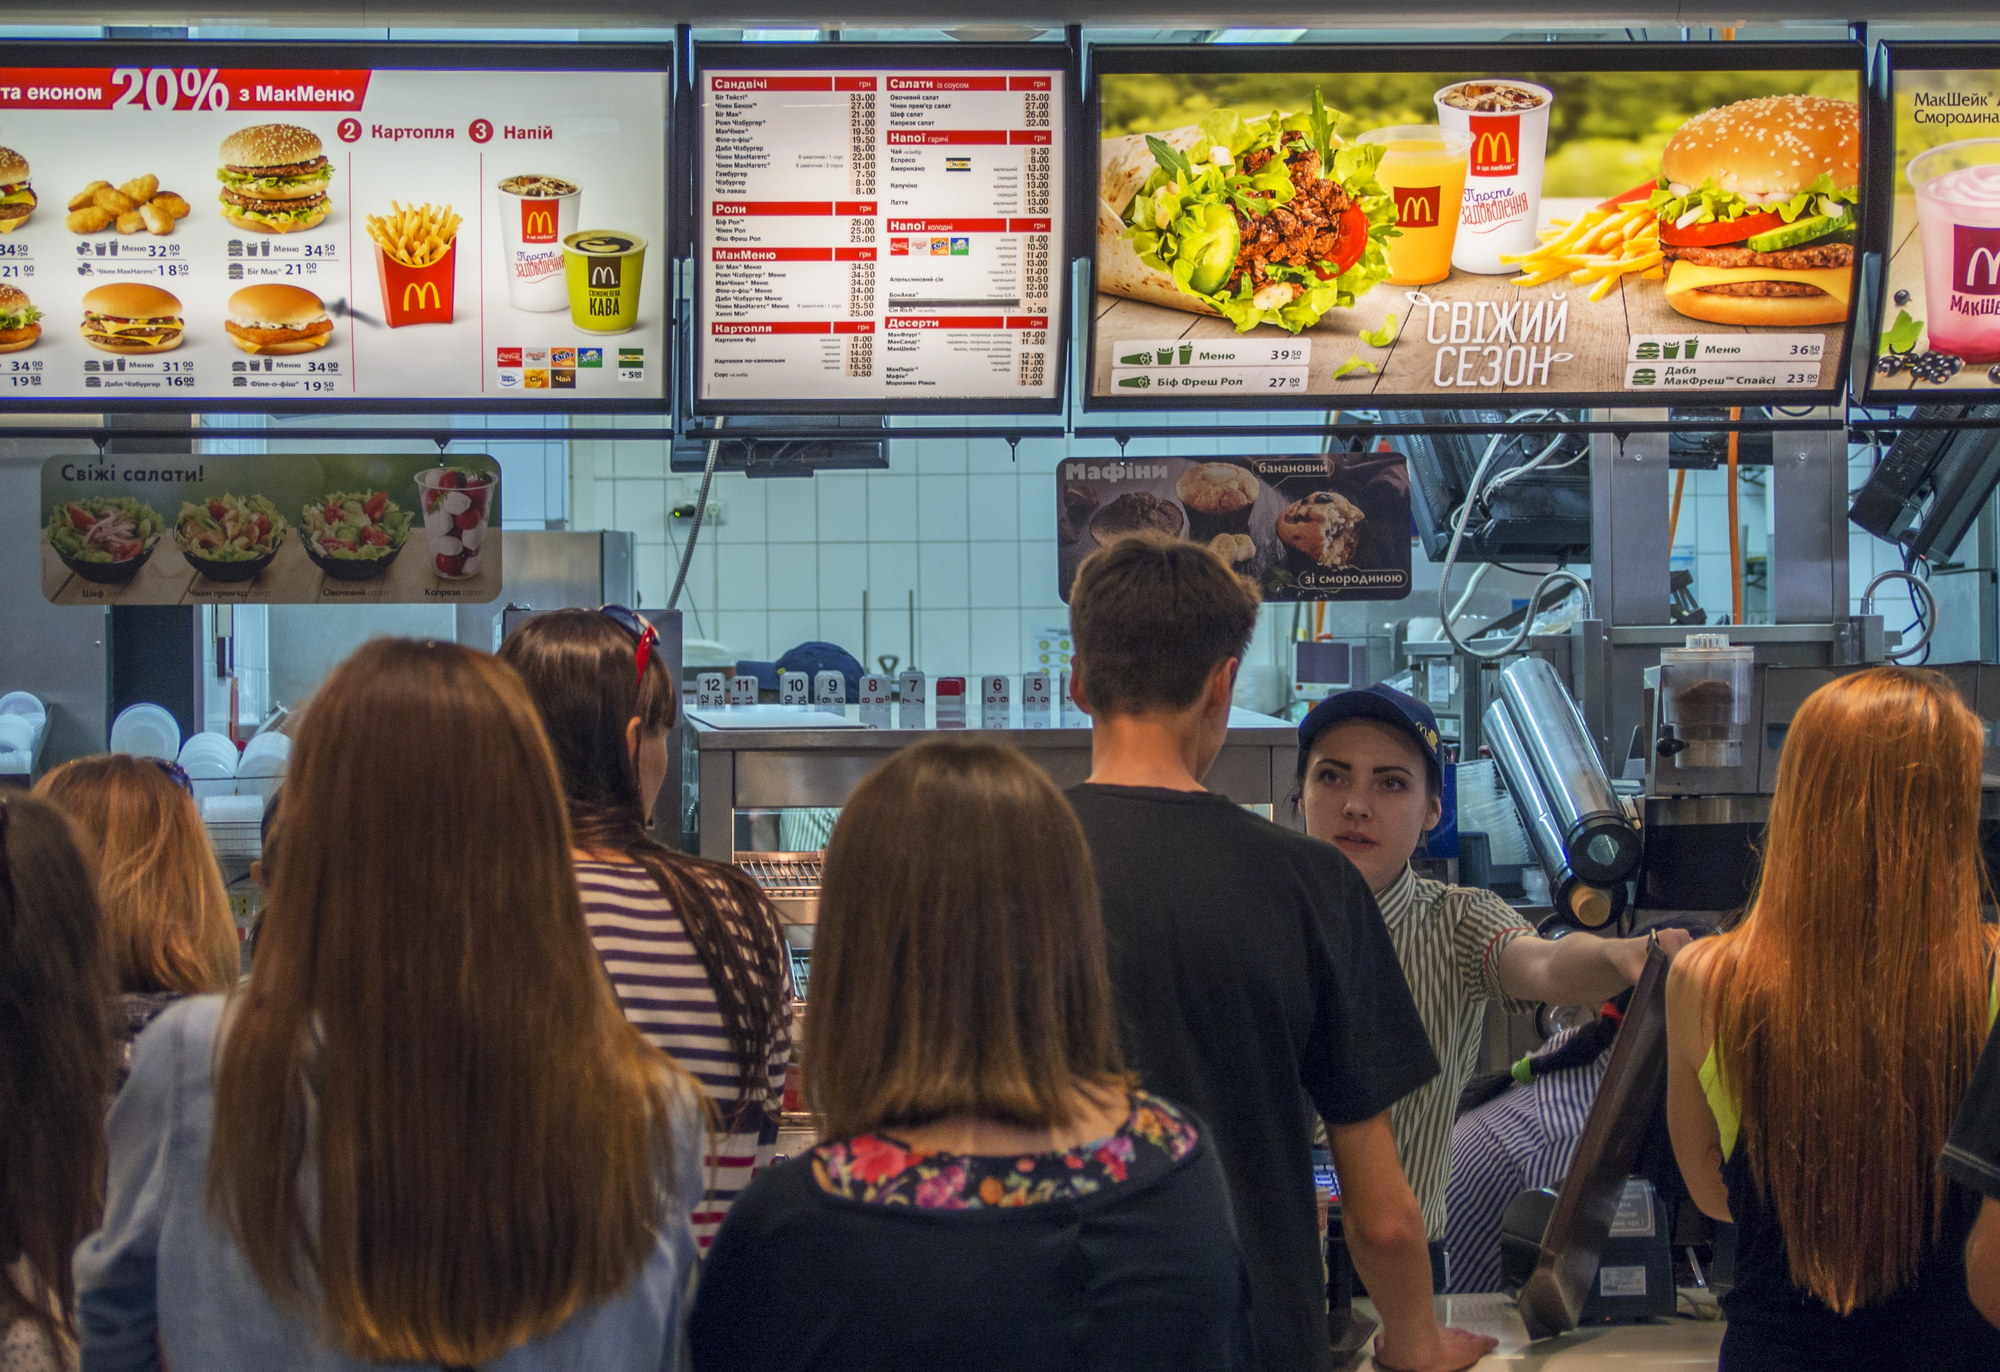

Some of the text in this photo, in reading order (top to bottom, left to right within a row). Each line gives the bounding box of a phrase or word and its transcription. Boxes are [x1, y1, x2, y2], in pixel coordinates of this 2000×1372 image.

[1, 66, 355, 111] та економ 20% з МакМеню
[715, 79, 871, 90] Сандвічі грн
[890, 79, 933, 89] Салати
[944, 82, 969, 91] соусом
[1025, 93, 1049, 101] 25.00
[851, 102, 875, 110] 27.00
[1025, 102, 1049, 110] 27.00
[1026, 110, 1049, 118] 26.00
[1914, 109, 2000, 127] Смородина
[851, 119, 875, 127] 21.00
[1026, 119, 1049, 127] 32.00
[343, 123, 455, 143] 2 Картопля
[475, 123, 553, 140] 3 Напій
[890, 132, 1046, 144] Напої гарячі грн
[852, 153, 875, 161] 22.00
[1030, 156, 1049, 164] 8.00
[852, 162, 876, 170] 31.00
[1028, 164, 1050, 172] 13.00
[856, 179, 875, 187] 8.00
[1027, 181, 1048, 189] 13.00
[1027, 198, 1048, 206] 13.00
[1464, 187, 1514, 206] Просте
[716, 204, 746, 214] Роли
[851, 218, 875, 226] 26.00
[890, 220, 925, 231] Напої
[927, 223, 953, 231] холодні
[850, 227, 875, 235] 25.00
[850, 235, 875, 243] 25.00
[148, 245, 167, 257] 32
[304, 245, 323, 257] 34
[716, 250, 776, 260] МакМеню
[517, 251, 555, 263] Просте
[3, 266, 18, 277] 21
[158, 265, 177, 276] 18
[285, 264, 302, 275] 21
[851, 263, 874, 271] 34.50
[590, 298, 620, 316] КАВА
[1426, 291, 1569, 345] СВІЖИЙ
[715, 324, 772, 335] Картопля
[888, 319, 939, 329] Десерти
[1199, 351, 1235, 361] Меню
[1270, 350, 1289, 360] 39
[1705, 346, 1741, 354] Меню
[1790, 345, 1809, 355] 36
[11, 361, 30, 372] 34
[162, 361, 179, 372] 31
[308, 362, 326, 372] 34
[1433, 345, 1552, 387] СЕЗОН
[1665, 367, 1696, 376] Дабл
[11, 377, 29, 386] 19
[166, 377, 183, 386] 16
[1157, 377, 1179, 387] Біф
[1182, 377, 1217, 388] Фреш
[1220, 377, 1243, 387] Рол
[1268, 378, 1287, 388] 27
[1736, 376, 1776, 385] Спайсі
[1786, 374, 1804, 384] 23
[303, 381, 321, 391] 19
[61, 463, 204, 483] Свіжі салати!
[1065, 463, 1168, 483] Мафіни
[1258, 462, 1328, 474] банановий
[1304, 573, 1403, 586] зі смородиною
[82, 589, 104, 598] Шеф
[323, 588, 366, 596] Овочевий
[425, 588, 461, 598] Капрезе
[704, 678, 720, 691] 12
[735, 679, 749, 692] 11
[788, 679, 803, 692] 10
[828, 679, 837, 694] 9
[868, 679, 878, 692] 8
[909, 680, 918, 692] 7
[993, 679, 1002, 693] 6
[1033, 678, 1042, 690] 5
